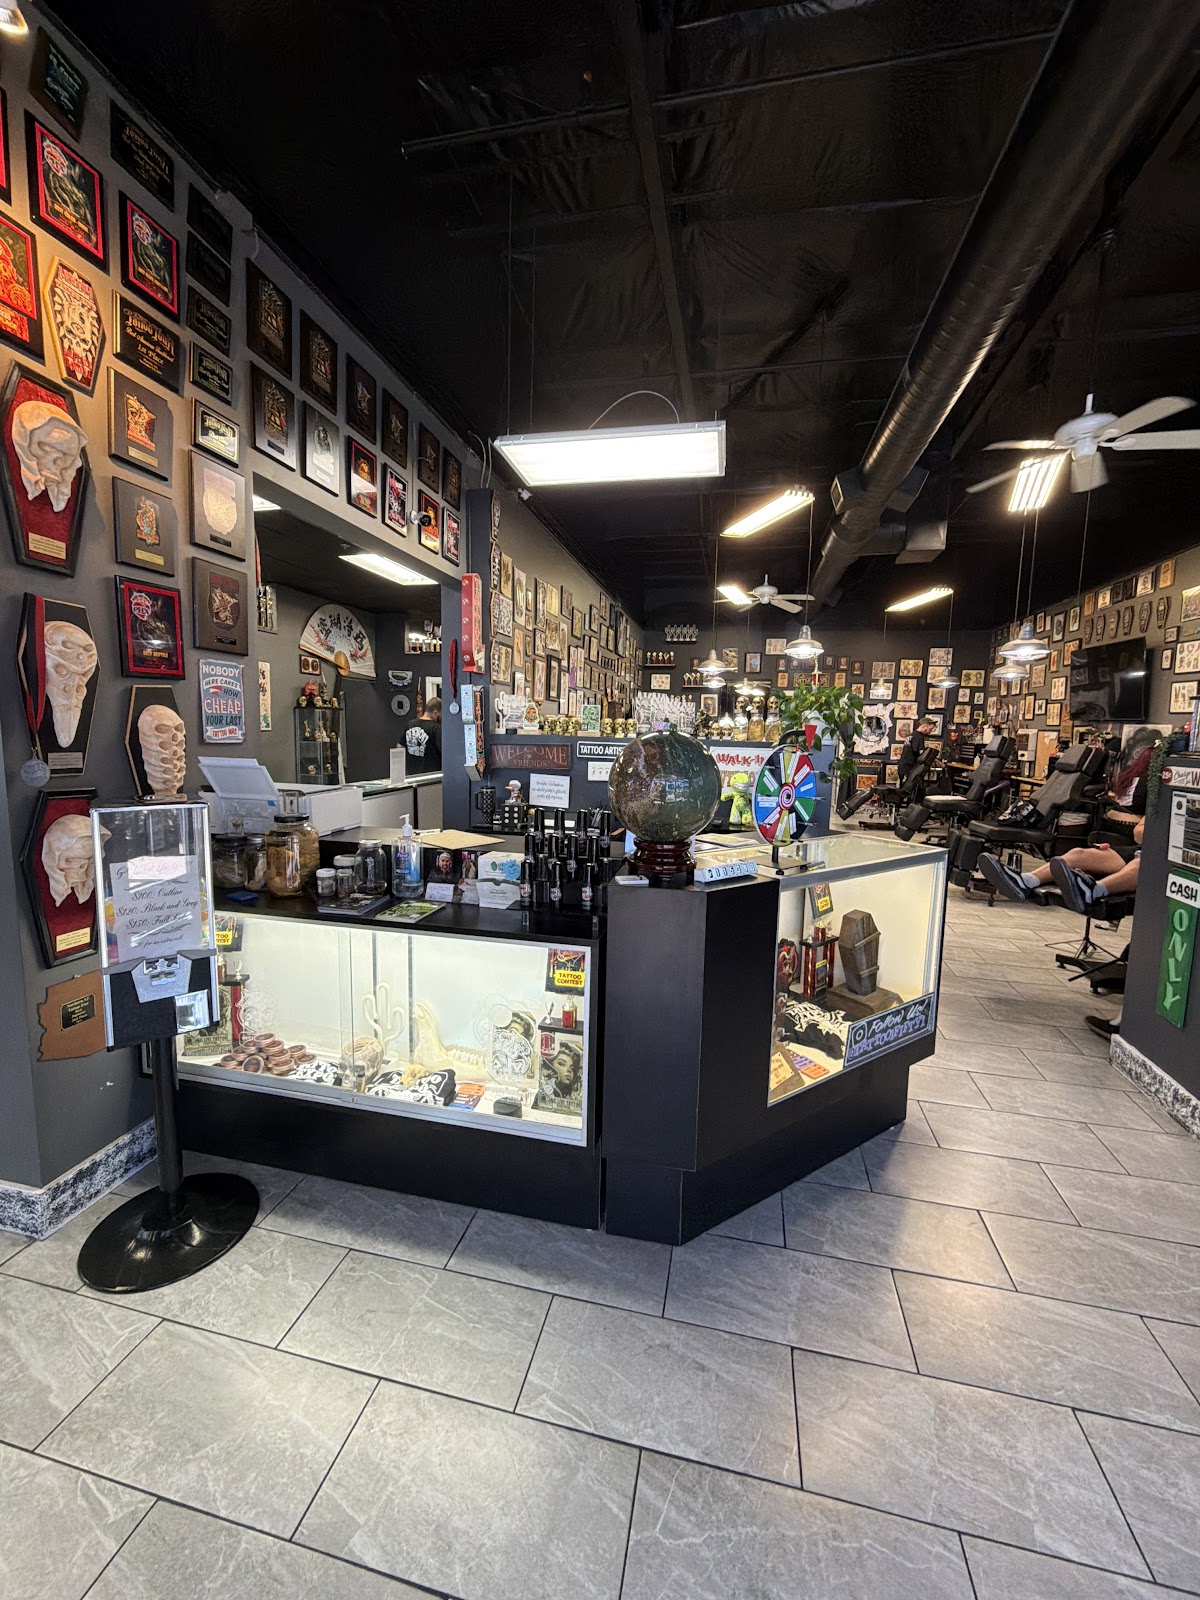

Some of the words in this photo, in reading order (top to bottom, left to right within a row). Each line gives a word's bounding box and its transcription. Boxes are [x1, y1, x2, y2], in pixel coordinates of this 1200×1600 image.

[202, 665, 239, 677] NOBODY
[204, 678, 218, 687] HERE
[220, 679, 239, 688] CARES
[223, 688, 240, 698] HOW
[204, 697, 241, 714] CHEAP
[205, 715, 224, 726] YOUR
[225, 715, 242, 726] LAST
[212, 729, 227, 738] TATTOO
[491, 744, 568, 766] WELCOME
[580, 745, 603, 755] TATTOO
[604, 746, 625, 755] ARTIS
[513, 759, 547, 768] FRIENDS
[1169, 880, 1198, 903] CASH
[141, 902, 165, 914] Black
[166, 900, 181, 910] and
[182, 897, 199, 909] Grey
[151, 914, 169, 925] Full
[1163, 908, 1189, 1011] ONLY
[559, 972, 582, 980] TATTOO
[556, 978, 583, 986] CONTEST
[868, 1009, 904, 1036] Follow
[905, 999, 929, 1019] Us!
